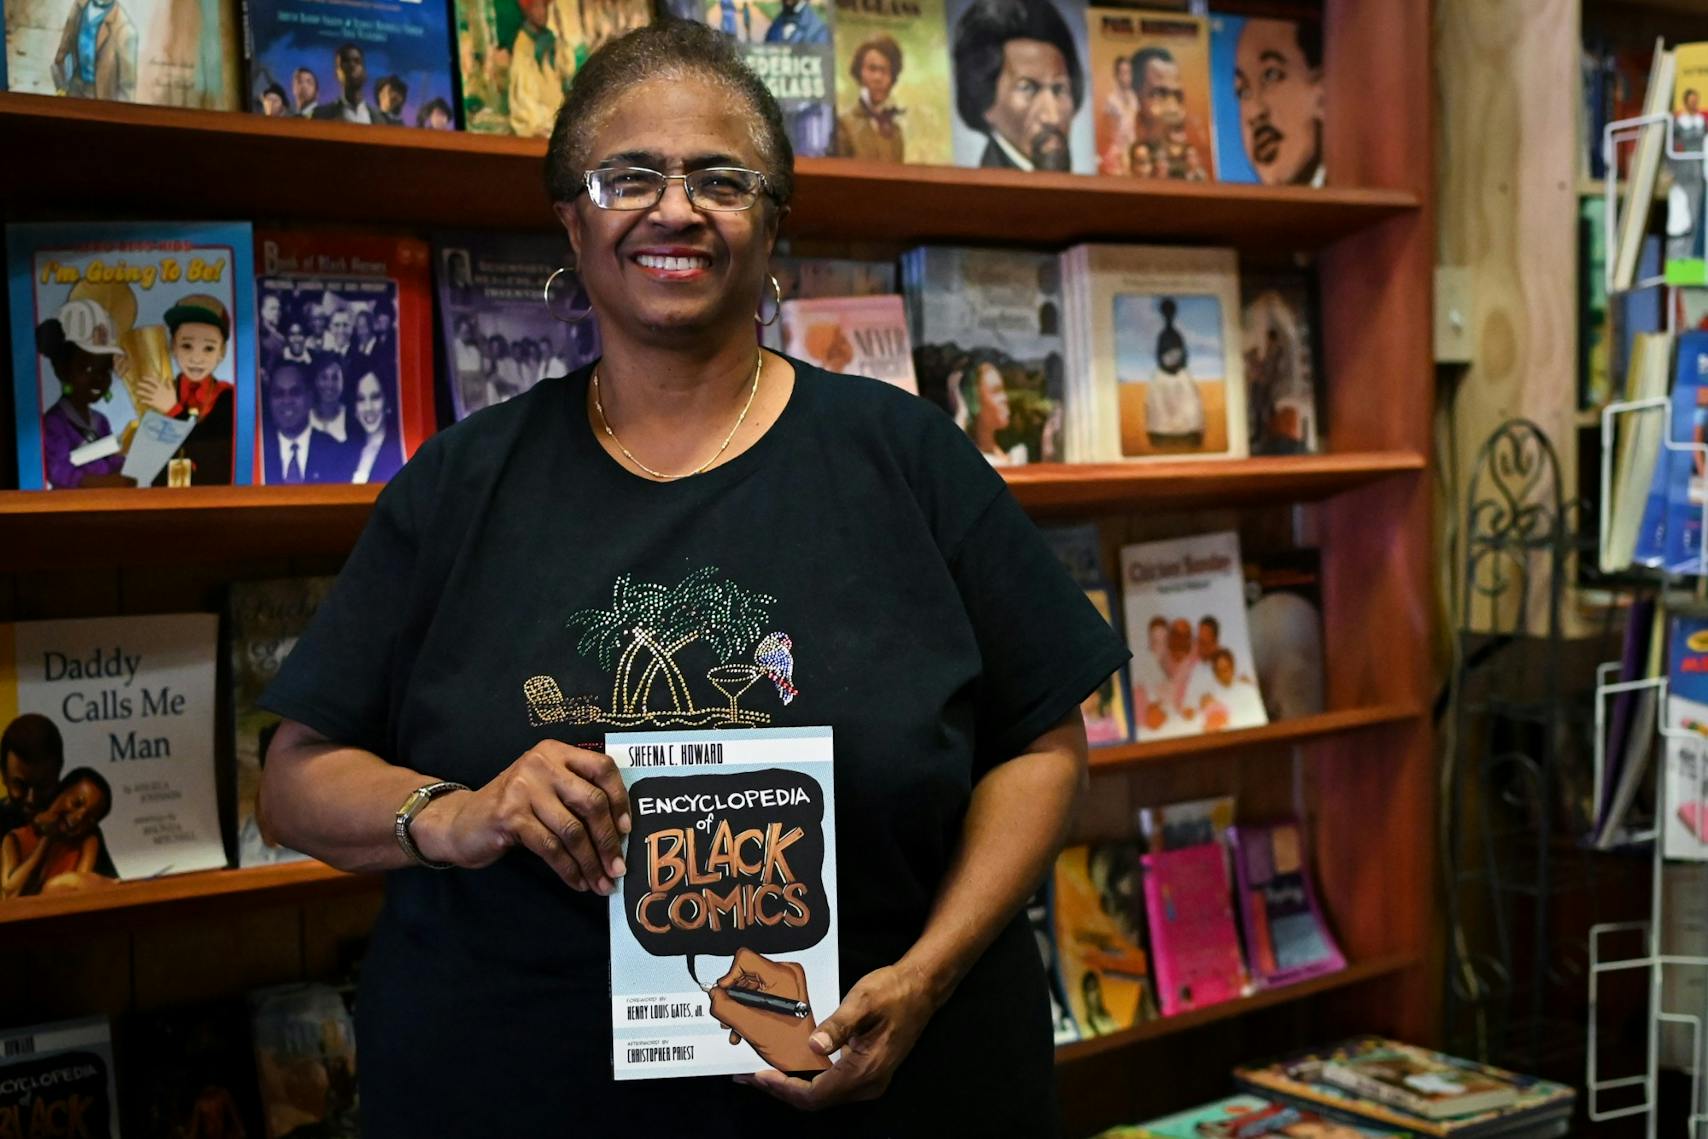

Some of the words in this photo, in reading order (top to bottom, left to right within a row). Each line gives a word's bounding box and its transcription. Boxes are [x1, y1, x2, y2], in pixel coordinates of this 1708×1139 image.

[41, 259, 79, 284] I'm
[85, 258, 156, 290] Going
[160, 258, 182, 283] To
[44, 647, 142, 687] Daddy
[62, 690, 133, 723] Calls
[140, 687, 186, 717] Me
[109, 731, 171, 763] Man
[629, 745, 665, 767] SHEENA
[669, 745, 678, 766] C.
[681, 743, 723, 766] HOWARD
[638, 787, 811, 815] ENCYCLOPEDIA
[696, 813, 714, 834] of
[644, 818, 805, 894] BLACK
[636, 882, 811, 934] COMICS
[627, 1005, 648, 1020] HENRY
[650, 1004, 669, 1019] LOUIS
[671, 1003, 693, 1018] GATES,
[627, 1047, 670, 1063] CHRISTOPHER
[672, 1045, 694, 1061] PRIEST
